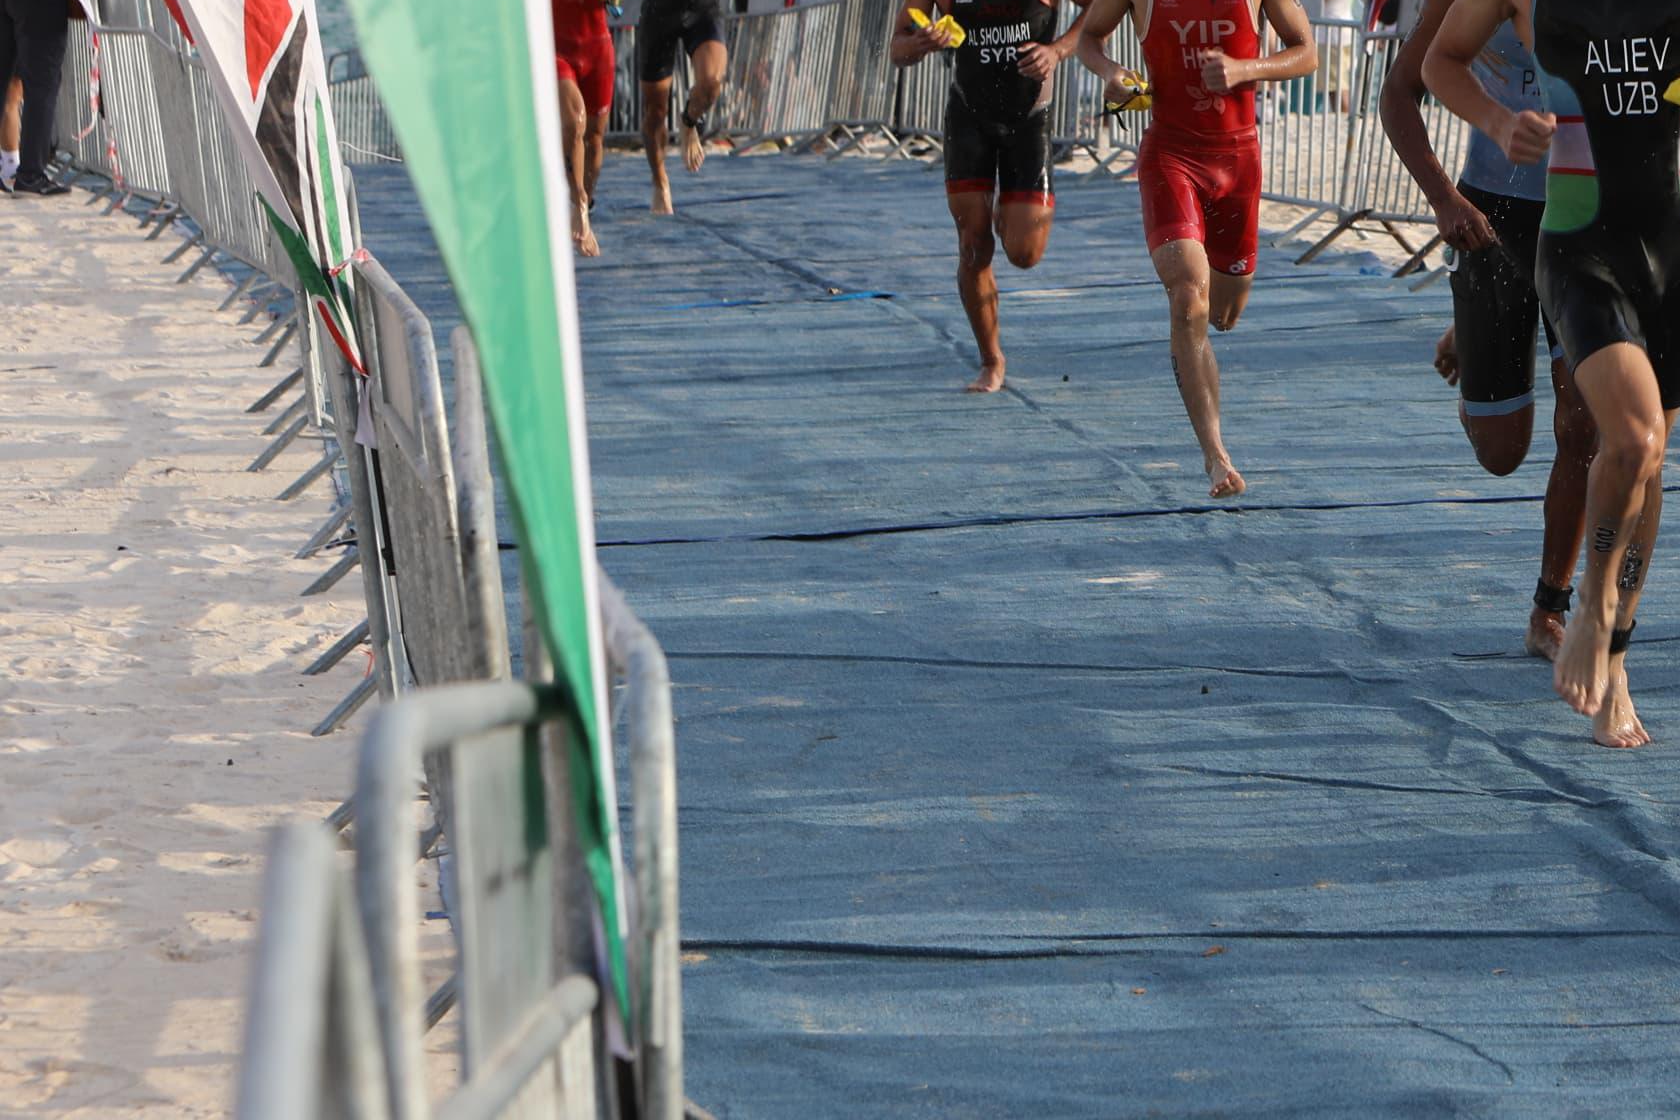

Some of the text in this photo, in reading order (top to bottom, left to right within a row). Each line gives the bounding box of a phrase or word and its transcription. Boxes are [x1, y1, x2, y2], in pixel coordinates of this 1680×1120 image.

[968, 21, 1031, 47] AL SHOUMARI
[1169, 19, 1236, 45] YIP
[980, 47, 1018, 64] SYR
[1585, 37, 1670, 75] ALIEV
[1603, 81, 1659, 116] UZB
